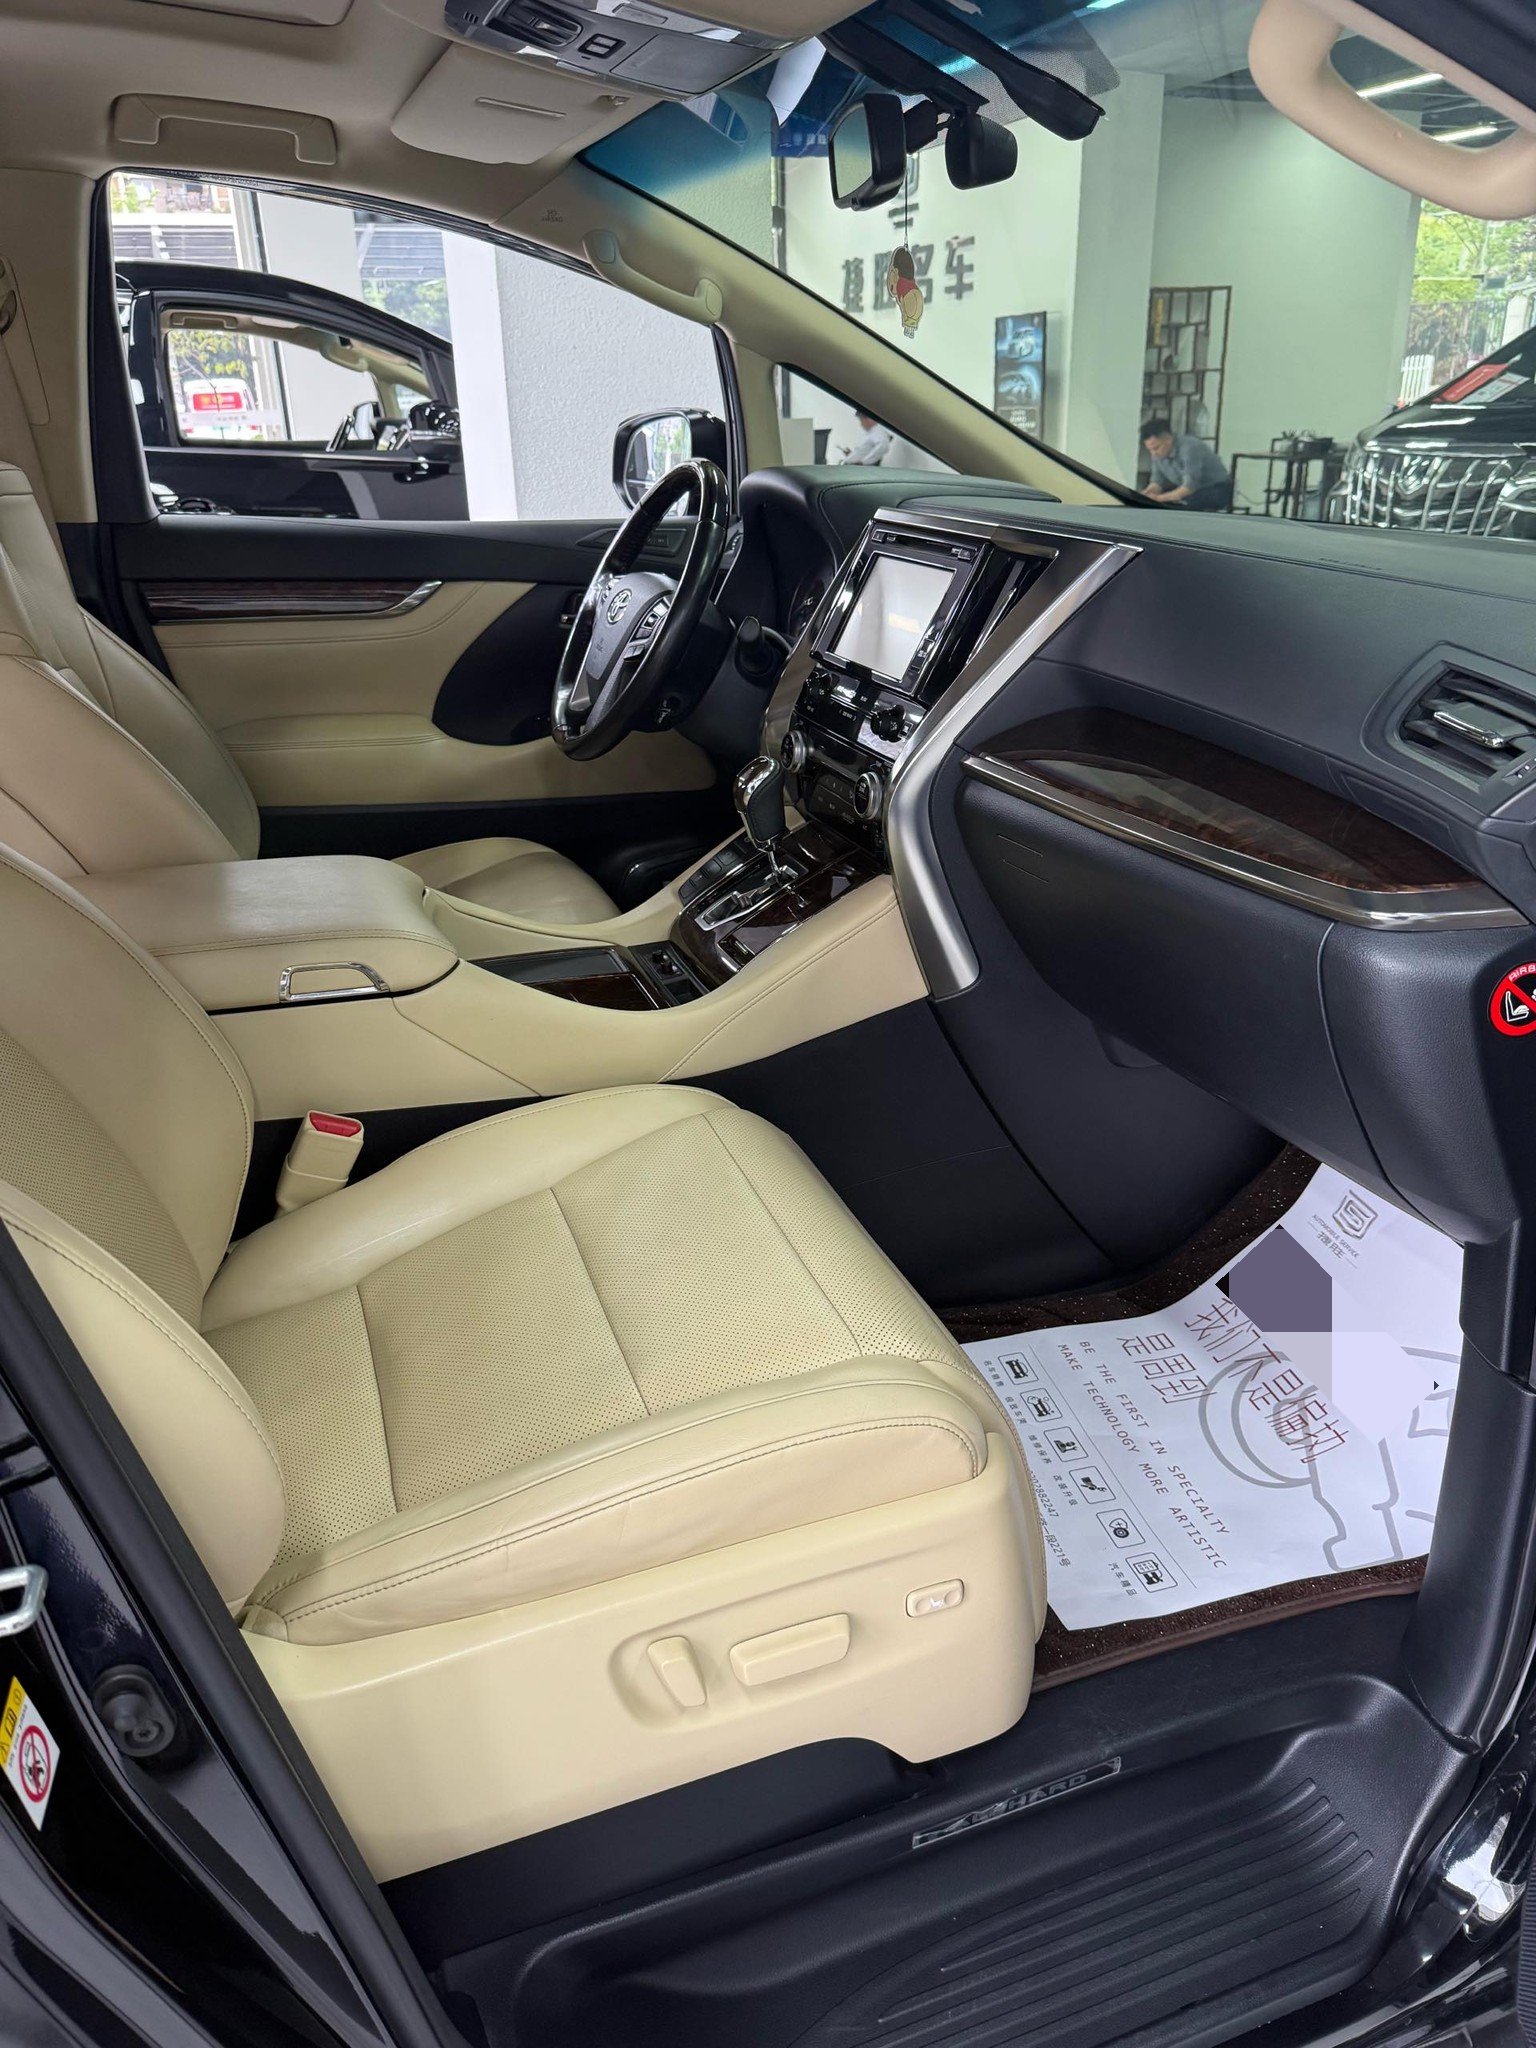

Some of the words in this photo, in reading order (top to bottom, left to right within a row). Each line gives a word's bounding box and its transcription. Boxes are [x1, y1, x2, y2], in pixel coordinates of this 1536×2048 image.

[1508, 964, 1536, 982] AIRB
[1340, 1238, 1360, 1258] SERVICE
[1116, 1333, 1217, 1404] 是周到
[1057, 1343, 1083, 1371] MAKE
[1082, 1380, 1140, 1454] TECHNOLOGY
[1138, 1462, 1169, 1495] MORE
[1168, 1506, 1228, 1569] ARTISTIC
[1079, 1340, 1096, 1354] BE
[1096, 1363, 1117, 1385] THE
[1116, 1393, 1149, 1428] FIRST
[1148, 1439, 1168, 1455] IN
[1167, 1465, 1231, 1535] SPECIALTY
